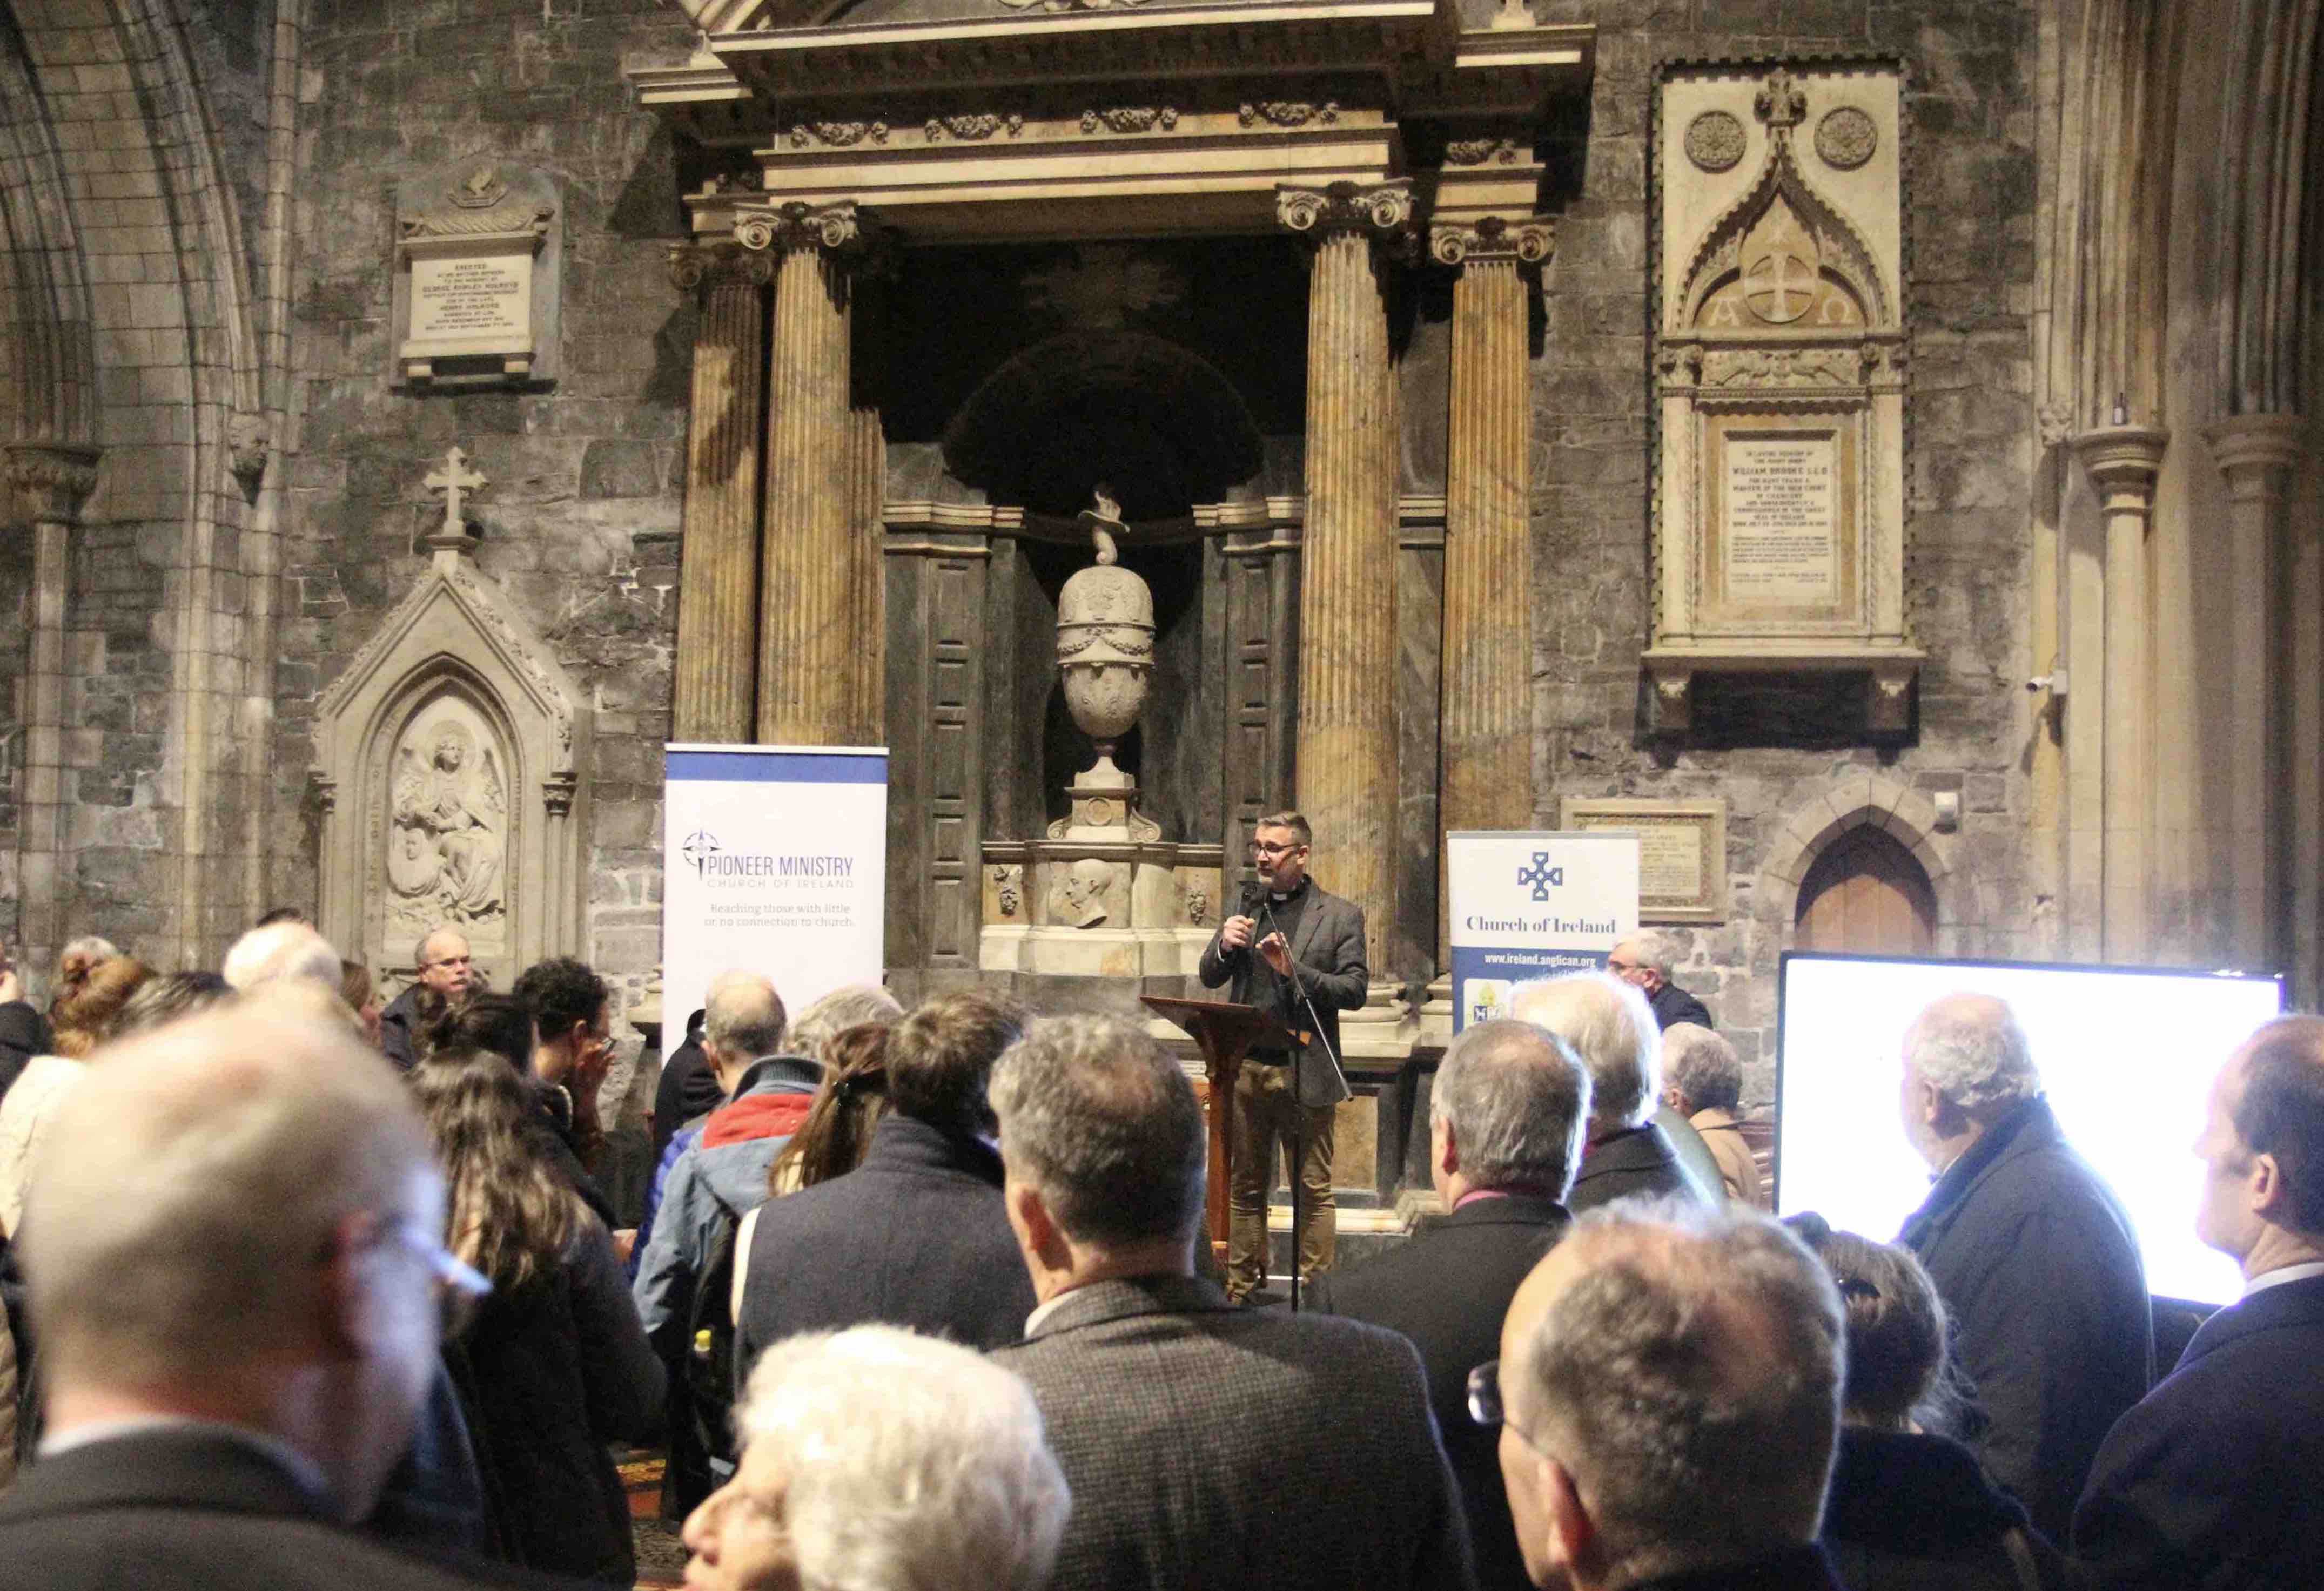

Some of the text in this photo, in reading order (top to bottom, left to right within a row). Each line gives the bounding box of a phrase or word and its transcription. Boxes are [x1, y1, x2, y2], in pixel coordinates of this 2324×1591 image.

[1732, 467, 1766, 476] WILLIAM
[708, 855, 854, 877] PIONEER MINISTRY
[707, 879, 854, 889] CHURCH OF IRELAND
[710, 904, 851, 915] Reaching those with little
[736, 918, 797, 927] connection
[799, 919, 812, 927] to
[1466, 915, 1616, 933] Church of Ireland
[1484, 953, 1596, 968] www.ireland.anglican.org
